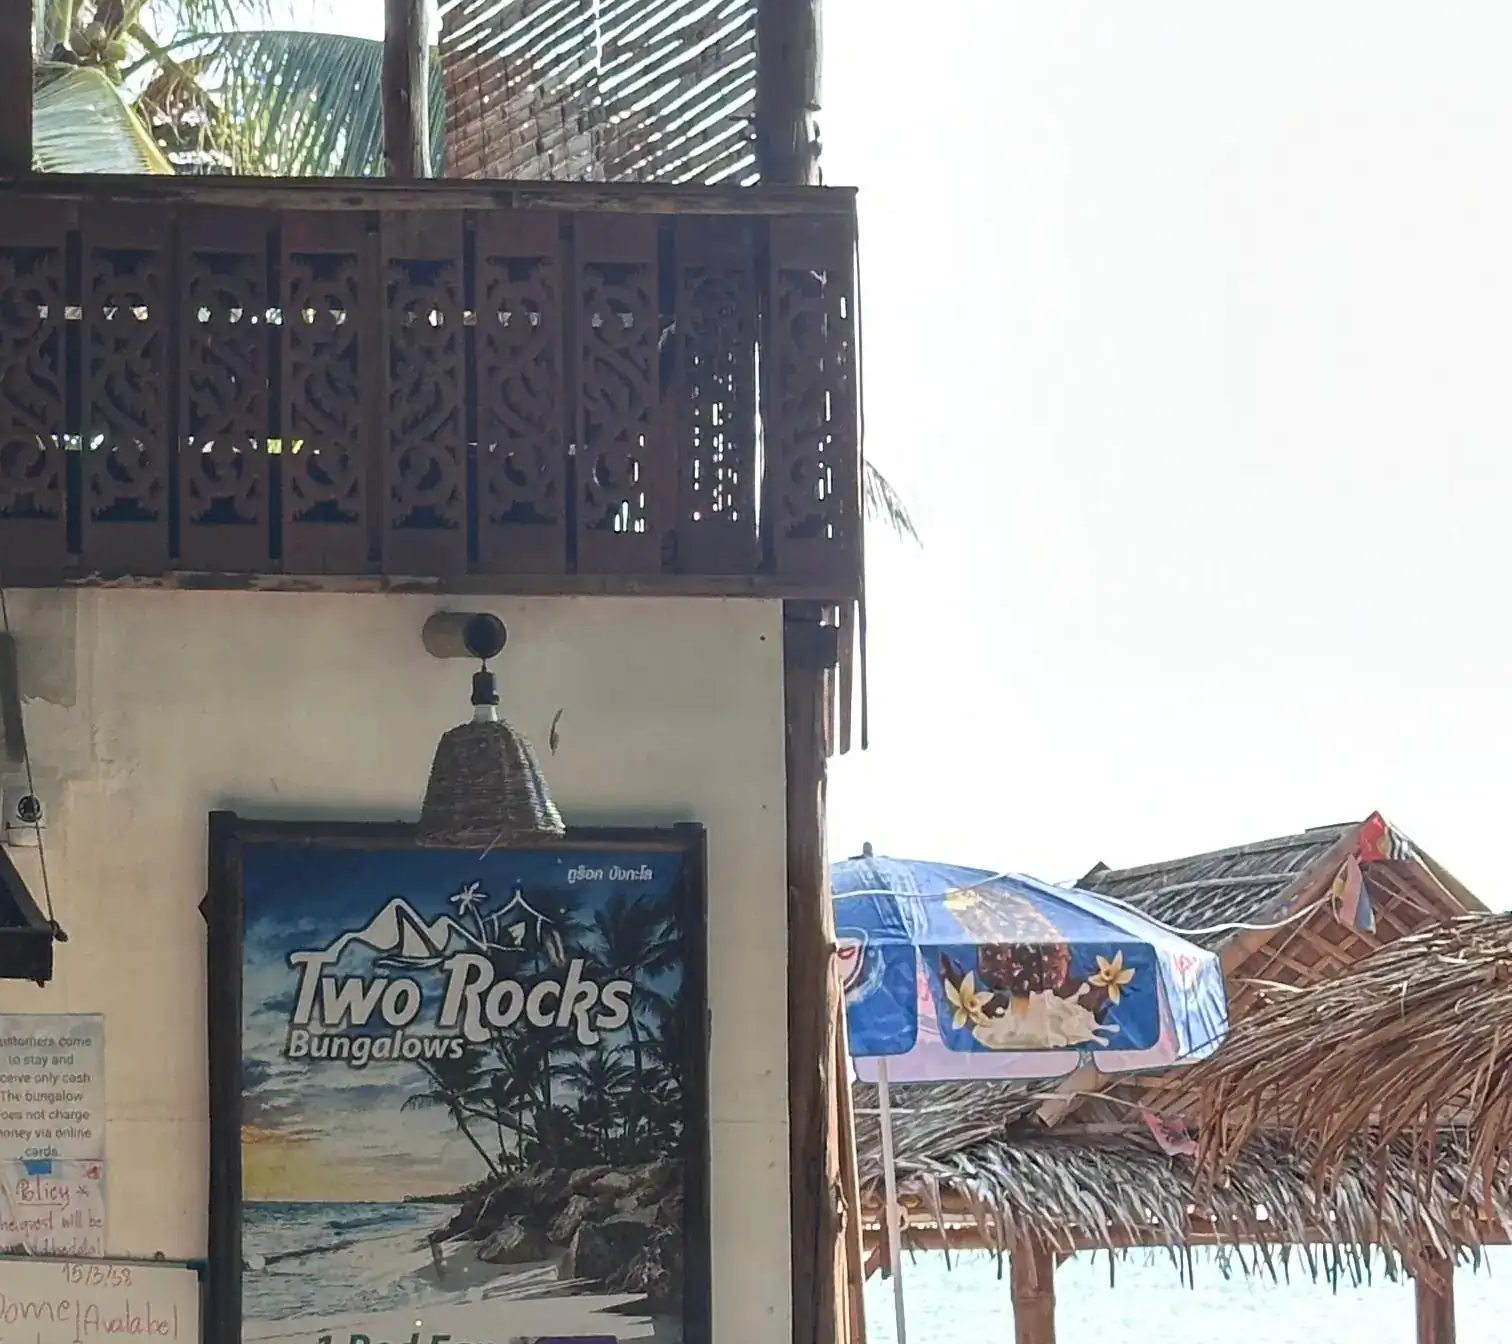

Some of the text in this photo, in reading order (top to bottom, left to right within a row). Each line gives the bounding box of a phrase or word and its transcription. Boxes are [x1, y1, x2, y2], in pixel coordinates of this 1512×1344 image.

[289, 951, 633, 1045] Two Rocks
[58, 1037, 93, 1048] come
[288, 1030, 464, 1065] Bungalows
[7, 1053, 75, 1068] to stay and
[34, 1072, 60, 1087] only
[0, 1089, 84, 1105] The bungalow
[25, 1108, 45, 1121] not
[48, 1108, 91, 1124] charge
[34, 1128, 53, 1139] via
[55, 1126, 93, 1139] online
